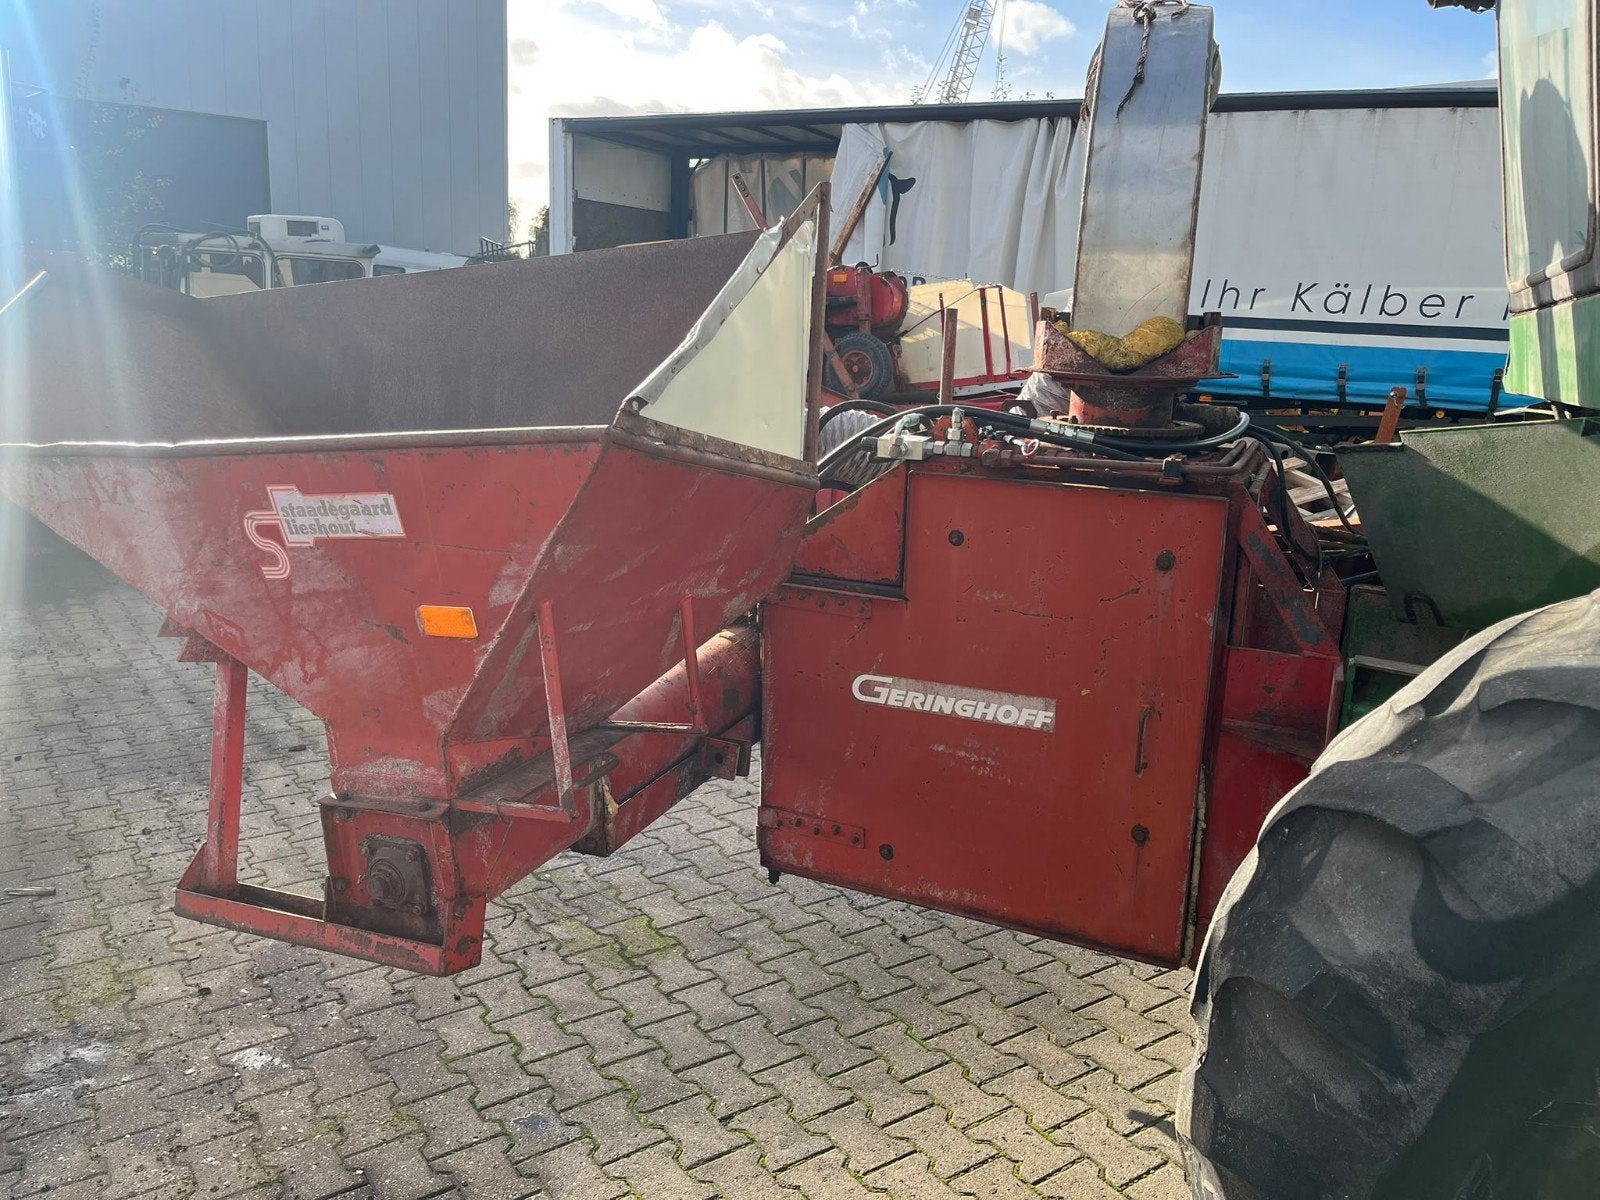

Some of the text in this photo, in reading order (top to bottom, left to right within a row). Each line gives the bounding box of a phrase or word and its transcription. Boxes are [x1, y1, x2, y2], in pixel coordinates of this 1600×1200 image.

[1200, 279, 1266, 310] Ihr
[1290, 282, 1474, 319] Kälber
[284, 518, 358, 536] lieshout
[851, 674, 1055, 728] GERINGHOFF
